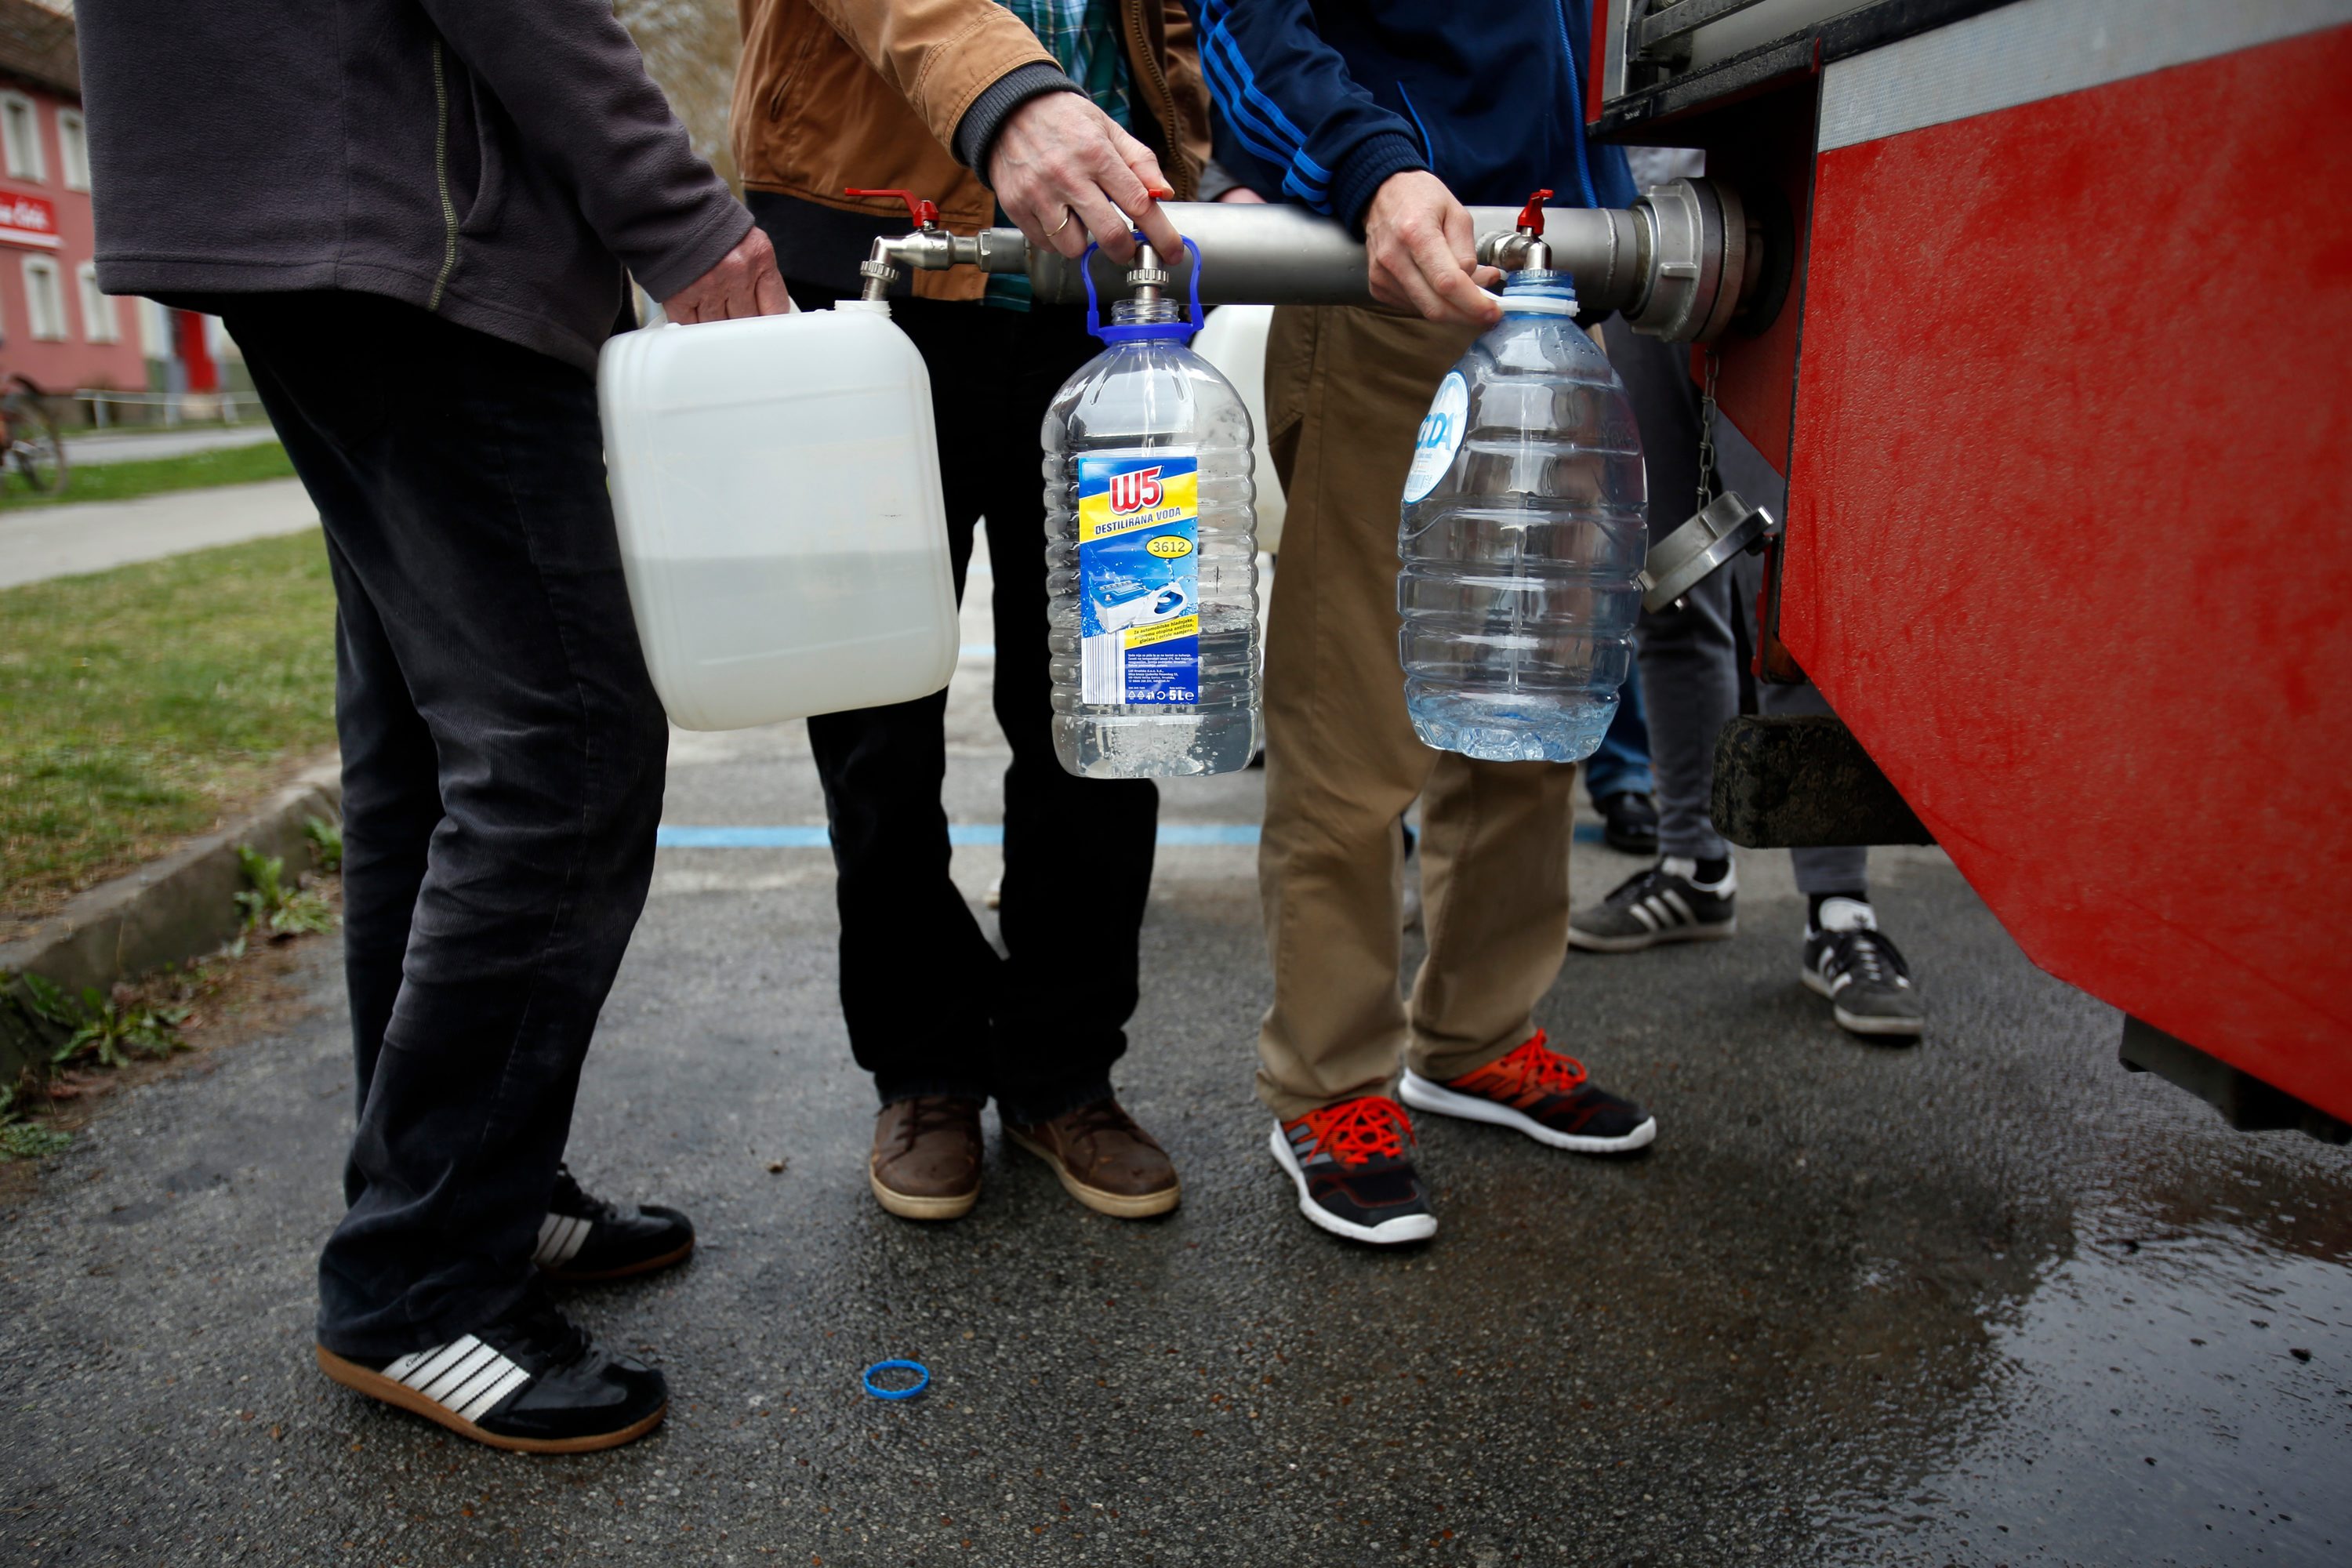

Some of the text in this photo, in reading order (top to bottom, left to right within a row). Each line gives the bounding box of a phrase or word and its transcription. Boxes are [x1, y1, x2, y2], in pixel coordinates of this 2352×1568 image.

[1110, 466, 1162, 514] W5
[1095, 507, 1181, 535] DESTILIRANA VODA
[1153, 542, 1185, 553] 3612
